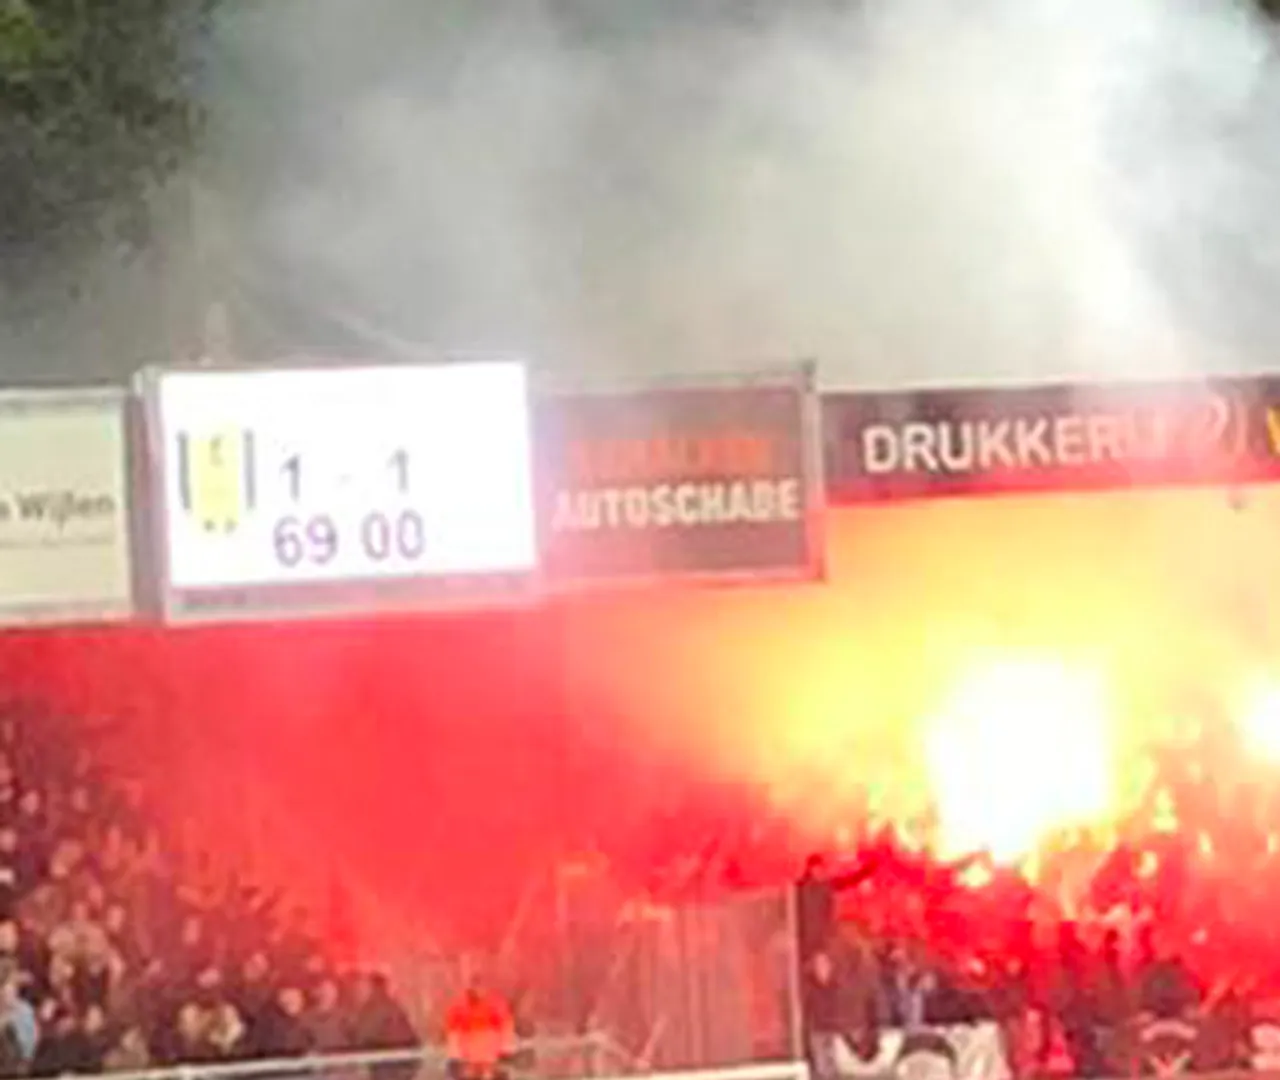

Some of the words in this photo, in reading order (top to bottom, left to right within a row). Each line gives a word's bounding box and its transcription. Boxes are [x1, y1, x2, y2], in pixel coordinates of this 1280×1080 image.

[279, 453, 299, 502] 1
[387, 448, 408, 494] 1
[551, 477, 800, 531] AUTOSCHADE
[272, 513, 339, 568] 69
